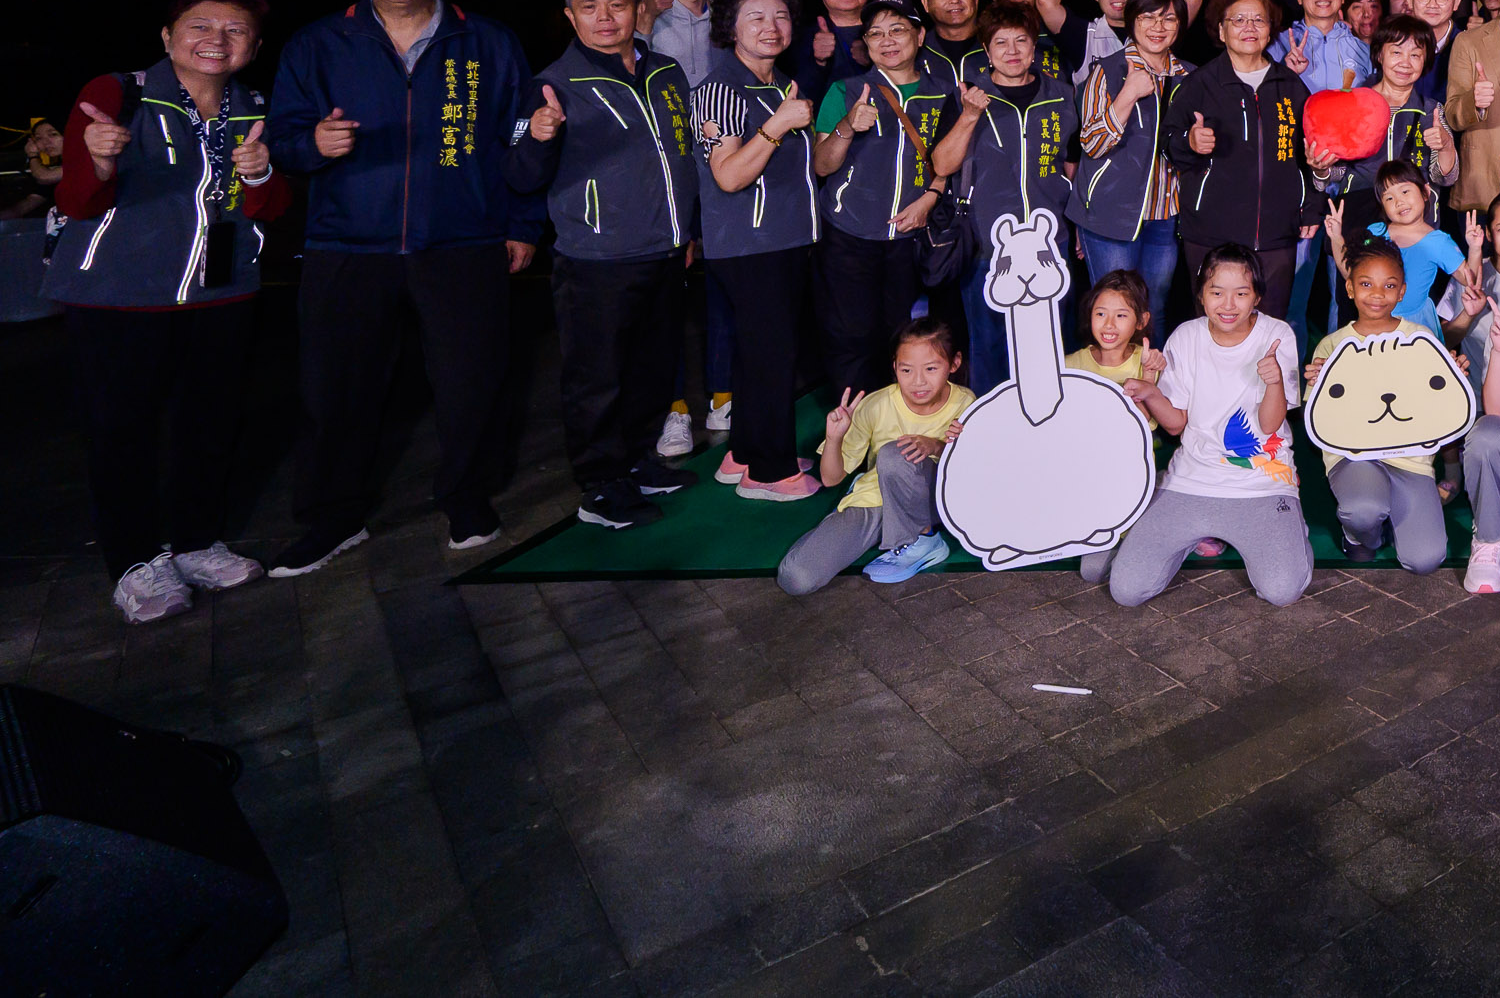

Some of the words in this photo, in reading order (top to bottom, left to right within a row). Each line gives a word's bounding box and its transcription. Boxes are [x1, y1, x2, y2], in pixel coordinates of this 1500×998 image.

[440, 103, 462, 167] 鄭富濃
[919, 113, 929, 134] 里長
[1041, 118, 1051, 139] 里長
[1051, 111, 1061, 142] 新店區
